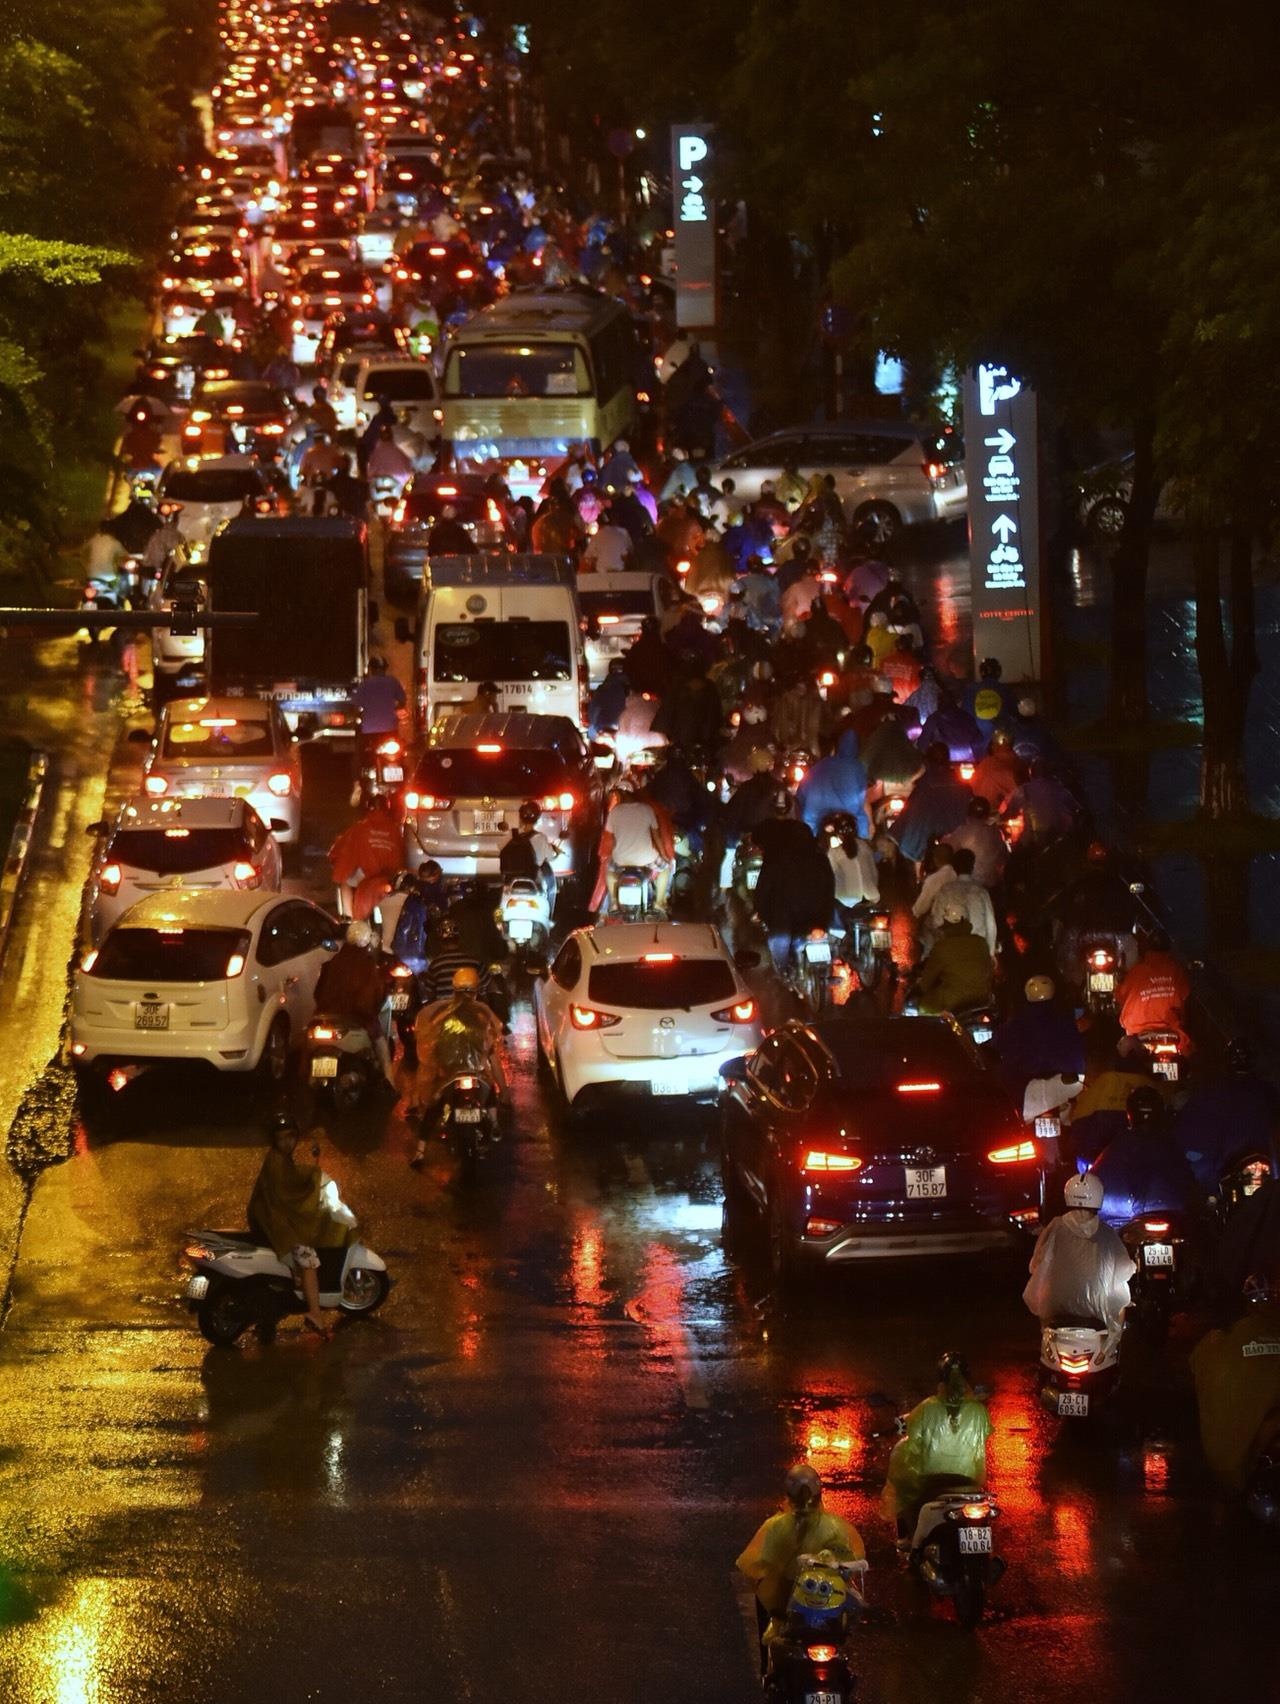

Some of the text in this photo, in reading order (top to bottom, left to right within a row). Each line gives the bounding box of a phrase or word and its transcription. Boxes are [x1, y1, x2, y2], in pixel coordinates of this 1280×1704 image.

[680, 137, 707, 170] P
[979, 363, 1021, 415] P
[915, 1170, 936, 1182] 30F
